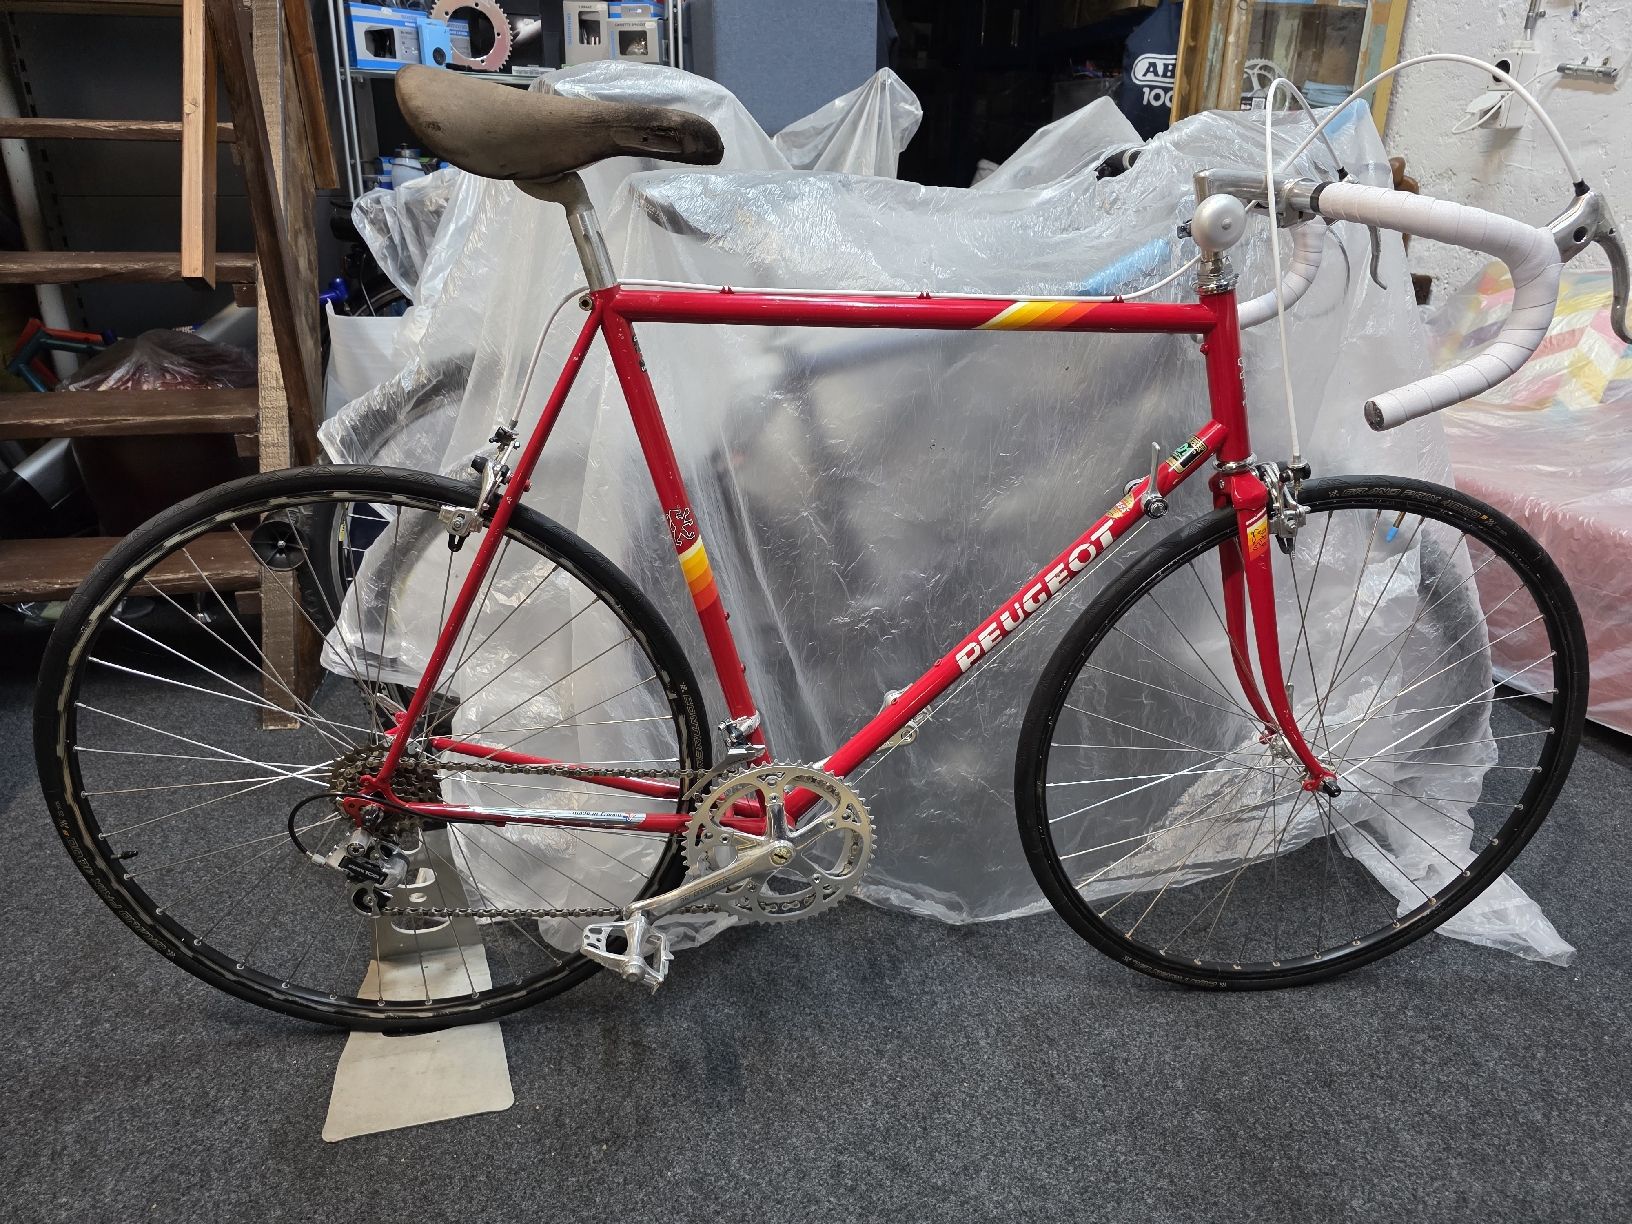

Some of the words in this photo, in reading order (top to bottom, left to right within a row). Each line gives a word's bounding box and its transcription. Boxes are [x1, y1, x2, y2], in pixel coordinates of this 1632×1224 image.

[1141, 61, 1176, 79] AB
[1341, 486, 1401, 497] GRAND
[1400, 489, 1442, 503] PRIX
[955, 518, 1114, 673] PEUGEOT
